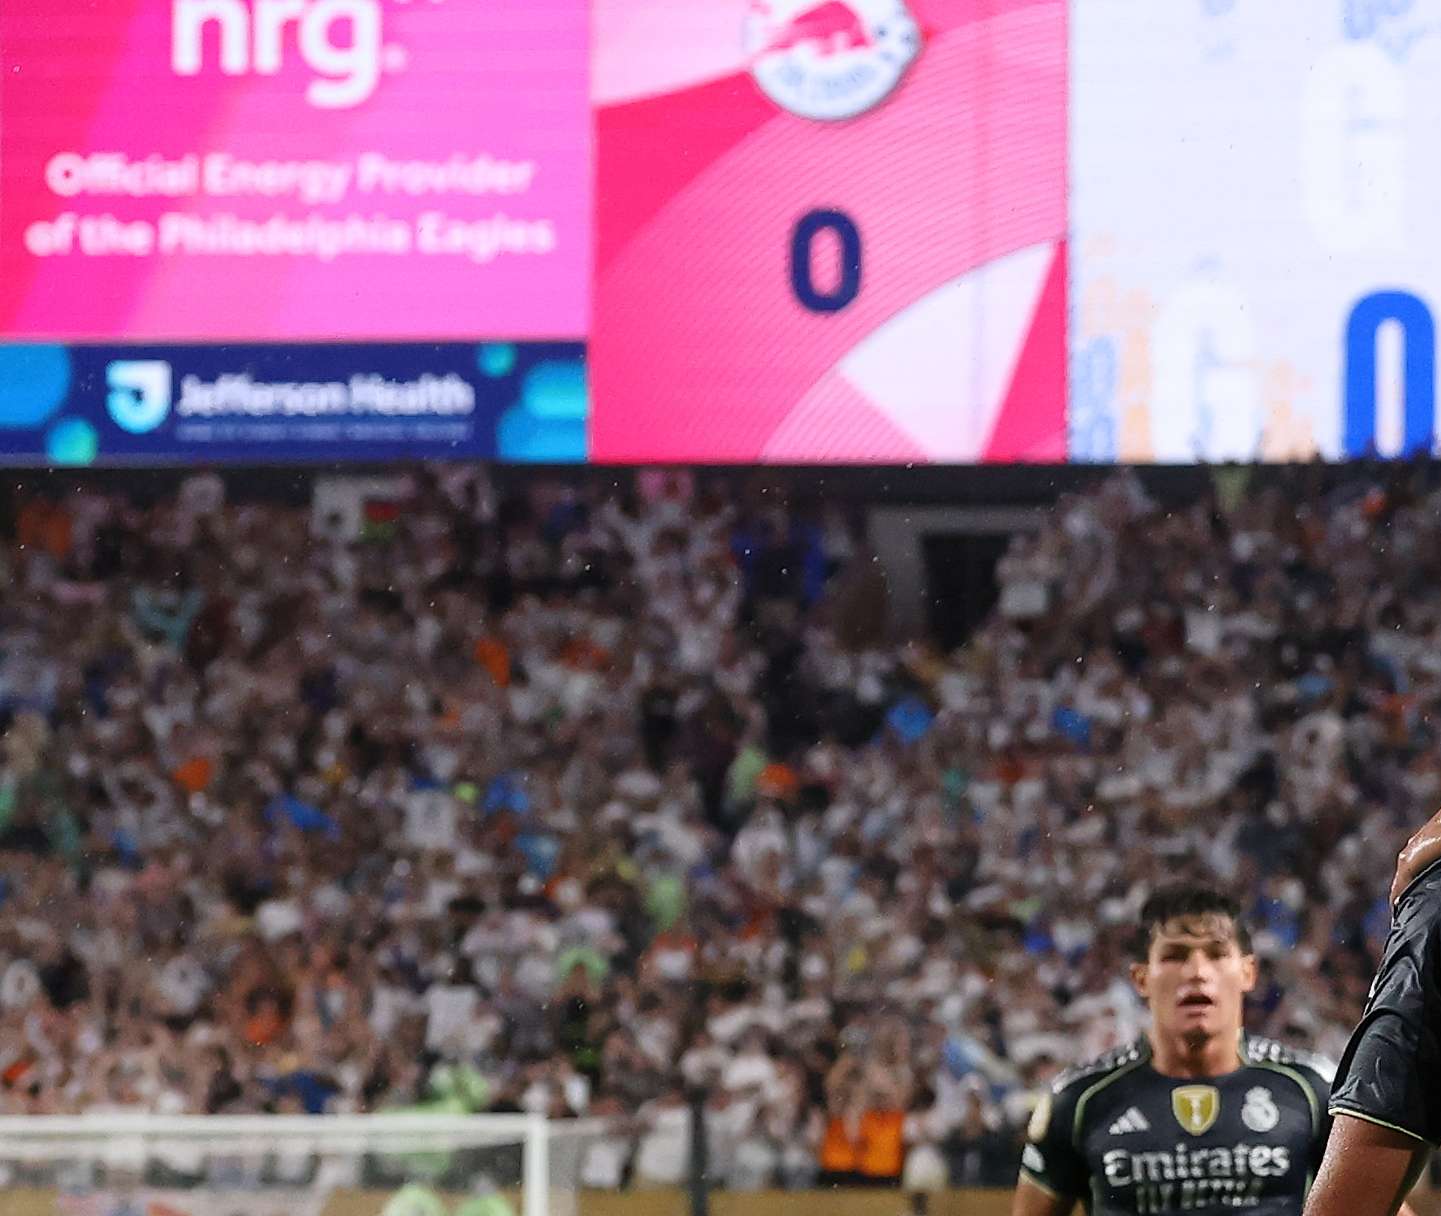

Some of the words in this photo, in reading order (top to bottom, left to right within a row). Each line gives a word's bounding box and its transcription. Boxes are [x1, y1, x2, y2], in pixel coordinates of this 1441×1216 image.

[46, 153, 198, 196] Official
[203, 153, 353, 204] Energy
[357, 153, 536, 195] Provider
[24, 213, 75, 257] of
[79, 213, 156, 257] the
[159, 212, 411, 262] Philadelphia
[416, 212, 558, 262] Eagles
[788, 207, 863, 315] 0
[177, 373, 348, 417] Jefferson
[350, 372, 476, 416] Health
[1103, 1142, 1291, 1187] Emirates
